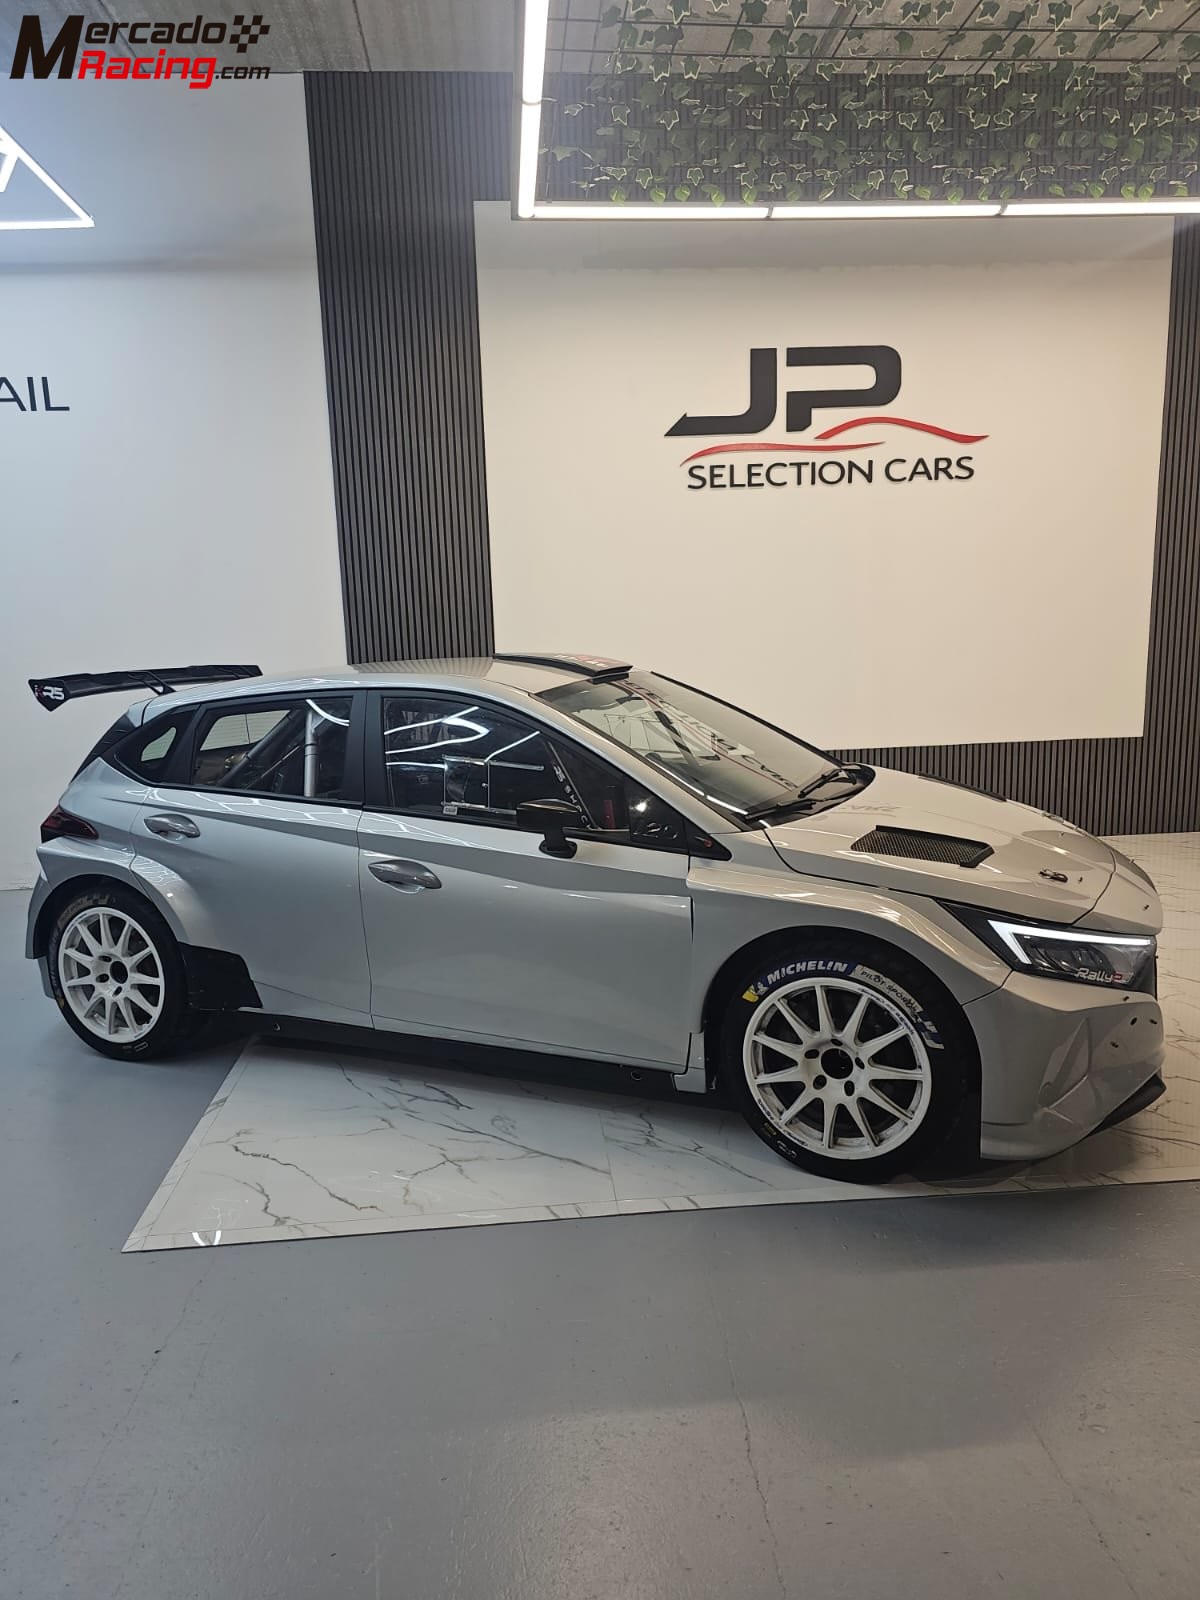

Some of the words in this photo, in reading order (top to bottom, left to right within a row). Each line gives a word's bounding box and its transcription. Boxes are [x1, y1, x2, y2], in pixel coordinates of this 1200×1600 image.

[664, 345, 902, 437] JP
[687, 461, 873, 490] SELECTION
[884, 456, 975, 483] CARS
[767, 961, 848, 985] MICHELIN
[861, 971, 886, 986] PILOT
